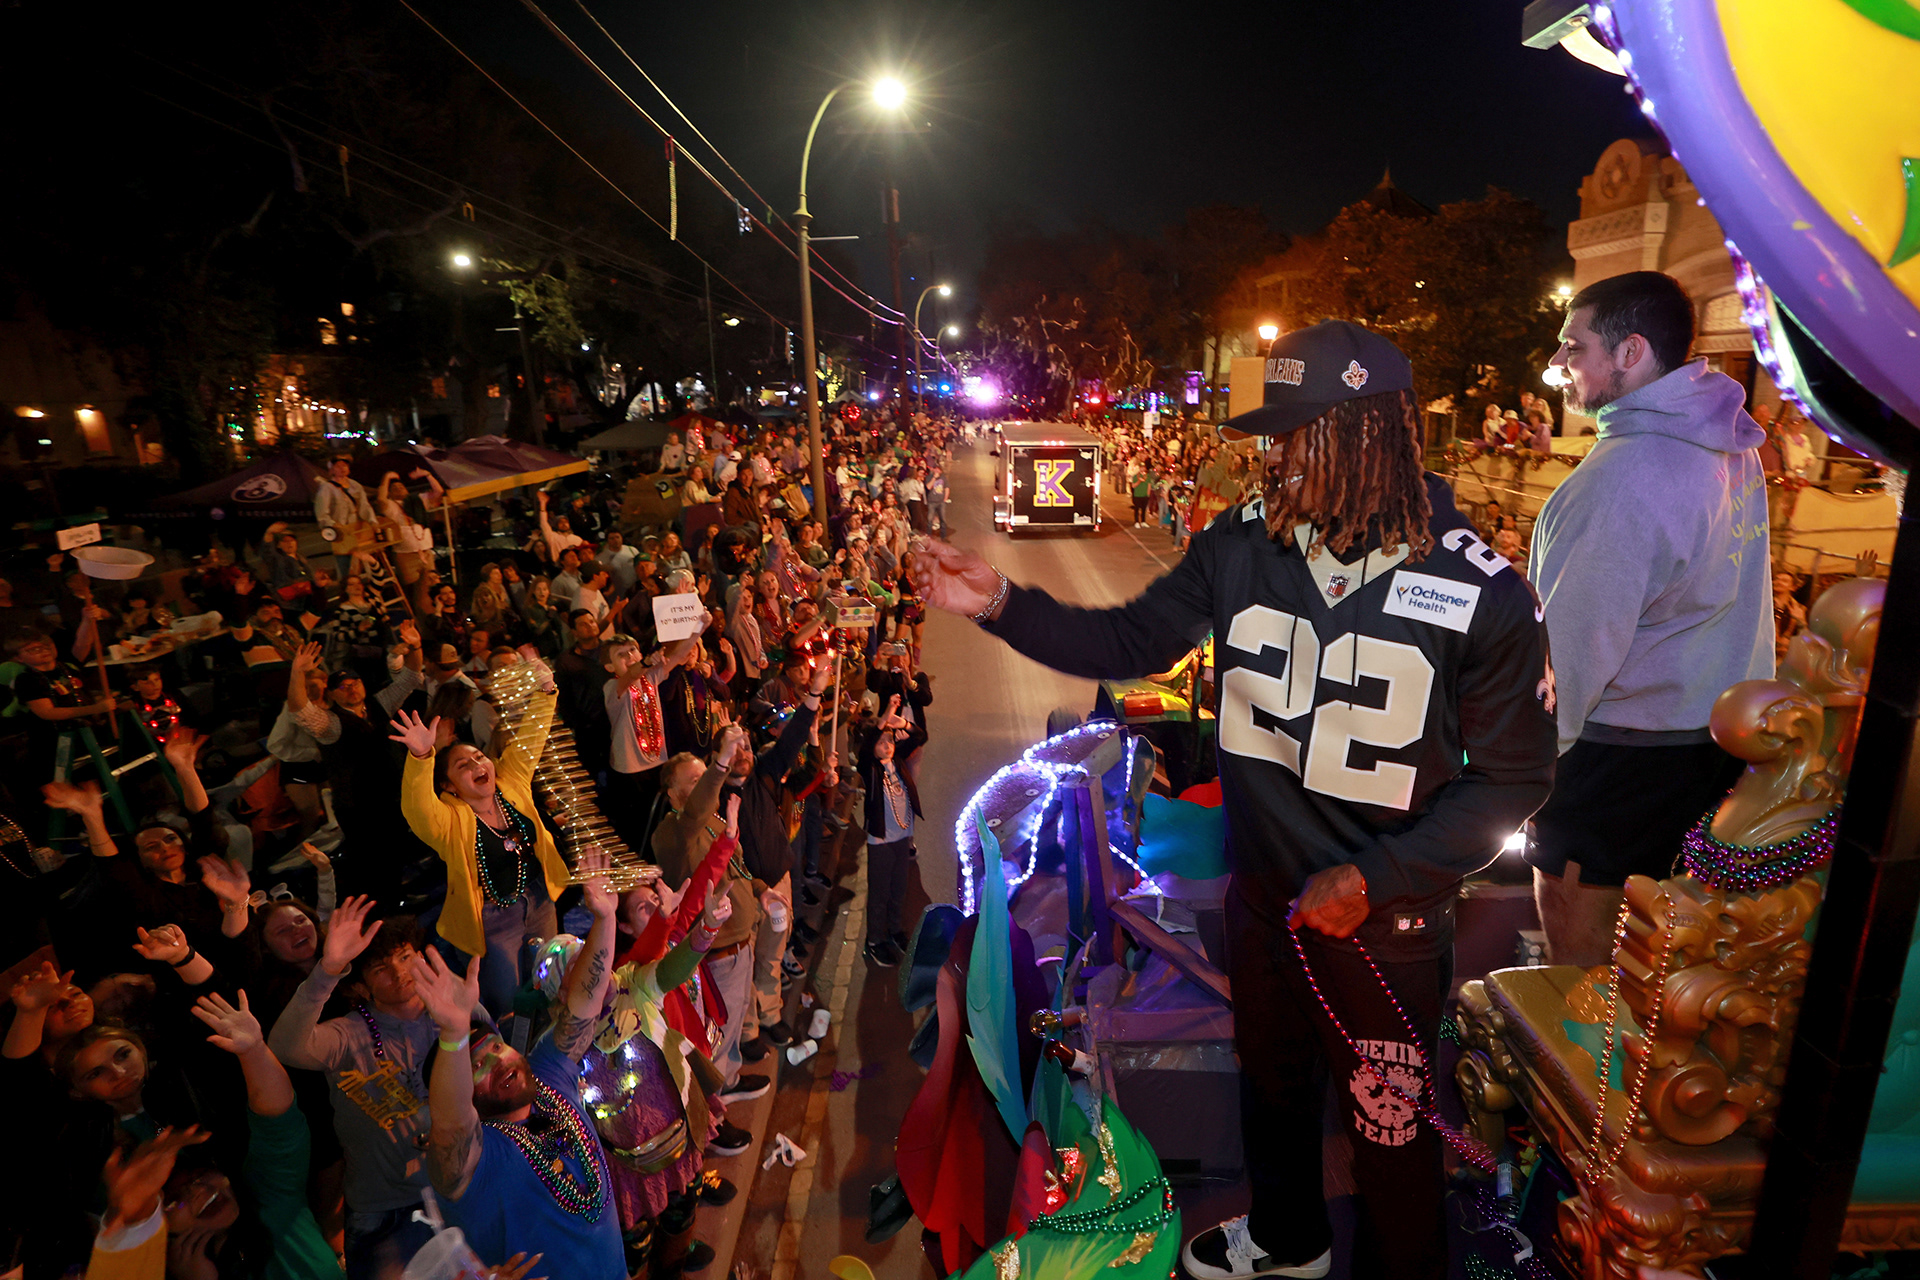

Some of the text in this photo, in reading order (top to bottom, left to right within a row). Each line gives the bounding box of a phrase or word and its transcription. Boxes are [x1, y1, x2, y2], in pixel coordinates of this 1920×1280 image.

[1264, 357, 1306, 387] RLEANS
[1033, 459, 1075, 507] K
[1441, 528, 1513, 578] 2
[684, 604, 696, 612] MY
[1408, 598, 1447, 615] Health
[1411, 585, 1470, 608] Ochsner
[672, 615, 700, 625] BIRTHD
[1219, 604, 1435, 811] 22
[1355, 1039, 1424, 1068] DENIM
[375, 1060, 426, 1115] Happy
[1353, 1109, 1418, 1147] TEARS
